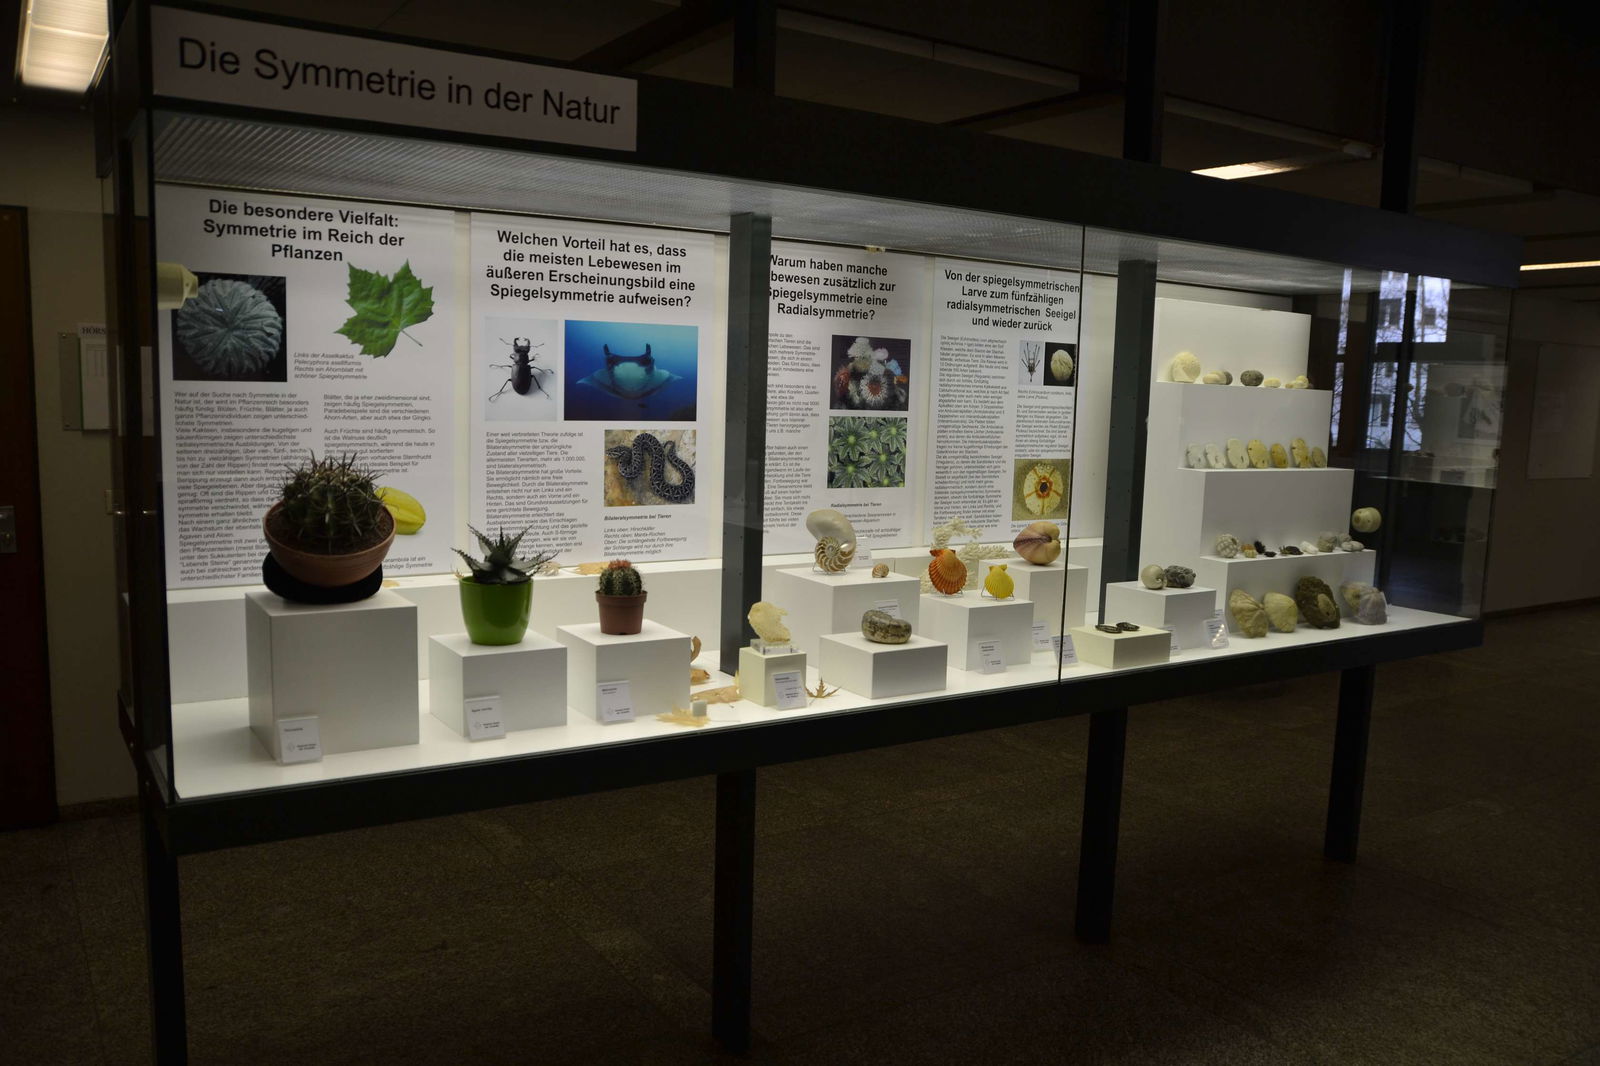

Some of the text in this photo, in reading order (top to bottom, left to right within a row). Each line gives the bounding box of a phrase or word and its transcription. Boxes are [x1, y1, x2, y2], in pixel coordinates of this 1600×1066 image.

[179, 37, 620, 124] Die Symmetrie in der Natur
[209, 199, 399, 228] Die besondere Vielfalt:
[204, 219, 404, 246] Symmetrie im Reich der
[497, 230, 686, 257] Welchen Vorteil hat es, dass
[272, 244, 343, 261] Pflanzen
[504, 250, 681, 273] die meisten Lebewesen im
[810, 258, 843, 272] haben
[846, 264, 888, 276] manche
[486, 266, 695, 291] äußeren Erscheinungsbild eine
[771, 271, 896, 292] bewesen zusätzlich zur
[944, 269, 1080, 293] Von der spiegelsymmetrischen
[490, 284, 691, 307] Spiegelsymmetrie aufweisen?
[866, 295, 888, 306] eine
[962, 286, 1064, 307] Larve zum fünfzähligen
[777, 303, 875, 320] Radialsymmetrie?
[947, 300, 1076, 321] radialsymmetrischen Seeigel
[972, 317, 1052, 331] und wieder zurück
